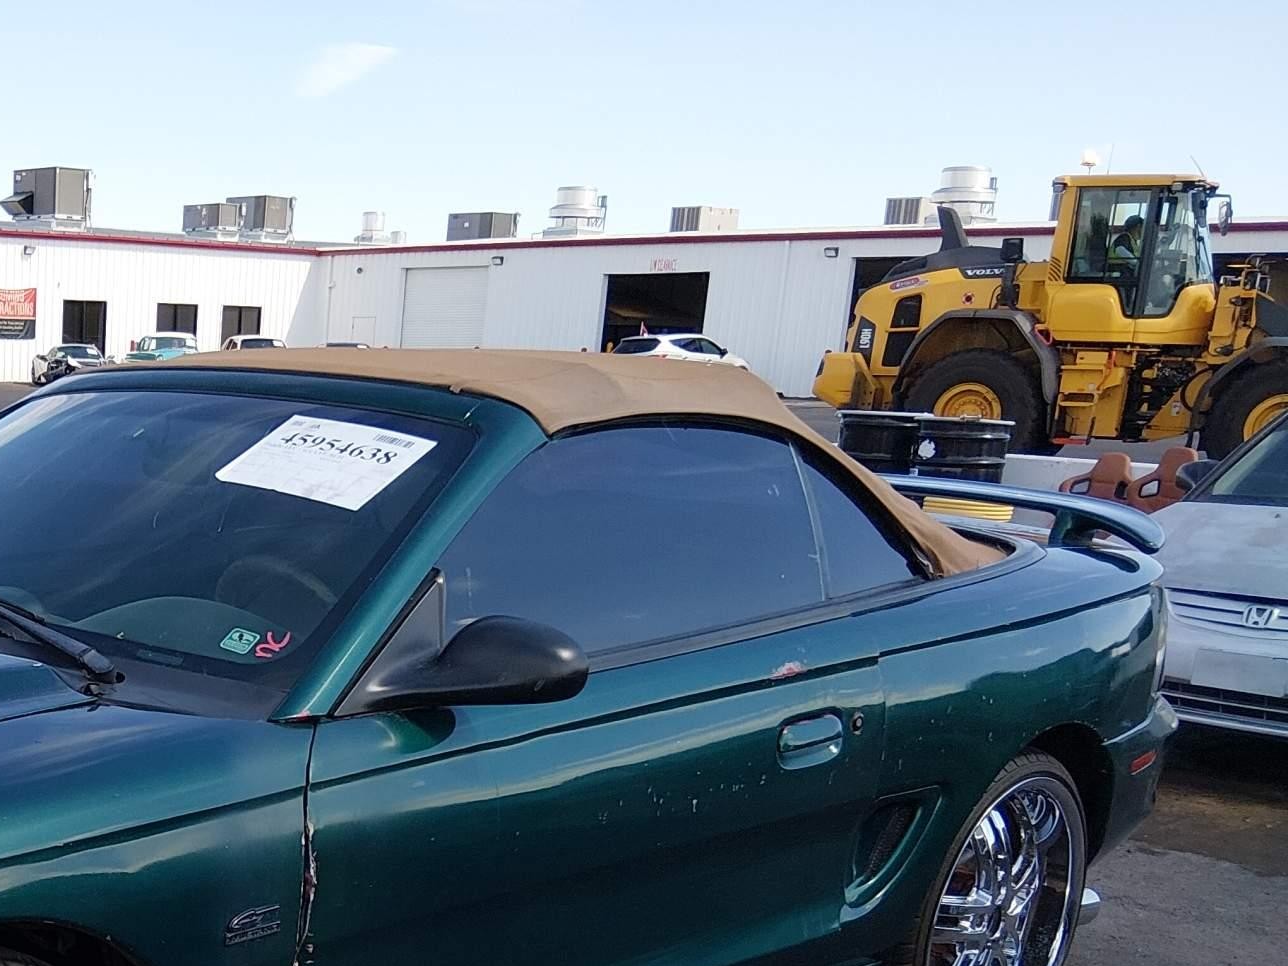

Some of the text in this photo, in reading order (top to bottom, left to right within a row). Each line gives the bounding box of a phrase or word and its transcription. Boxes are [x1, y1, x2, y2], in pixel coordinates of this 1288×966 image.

[965, 268, 1004, 276] VOLV
[859, 328, 872, 348] L90H
[281, 432, 398, 464] 45954638
